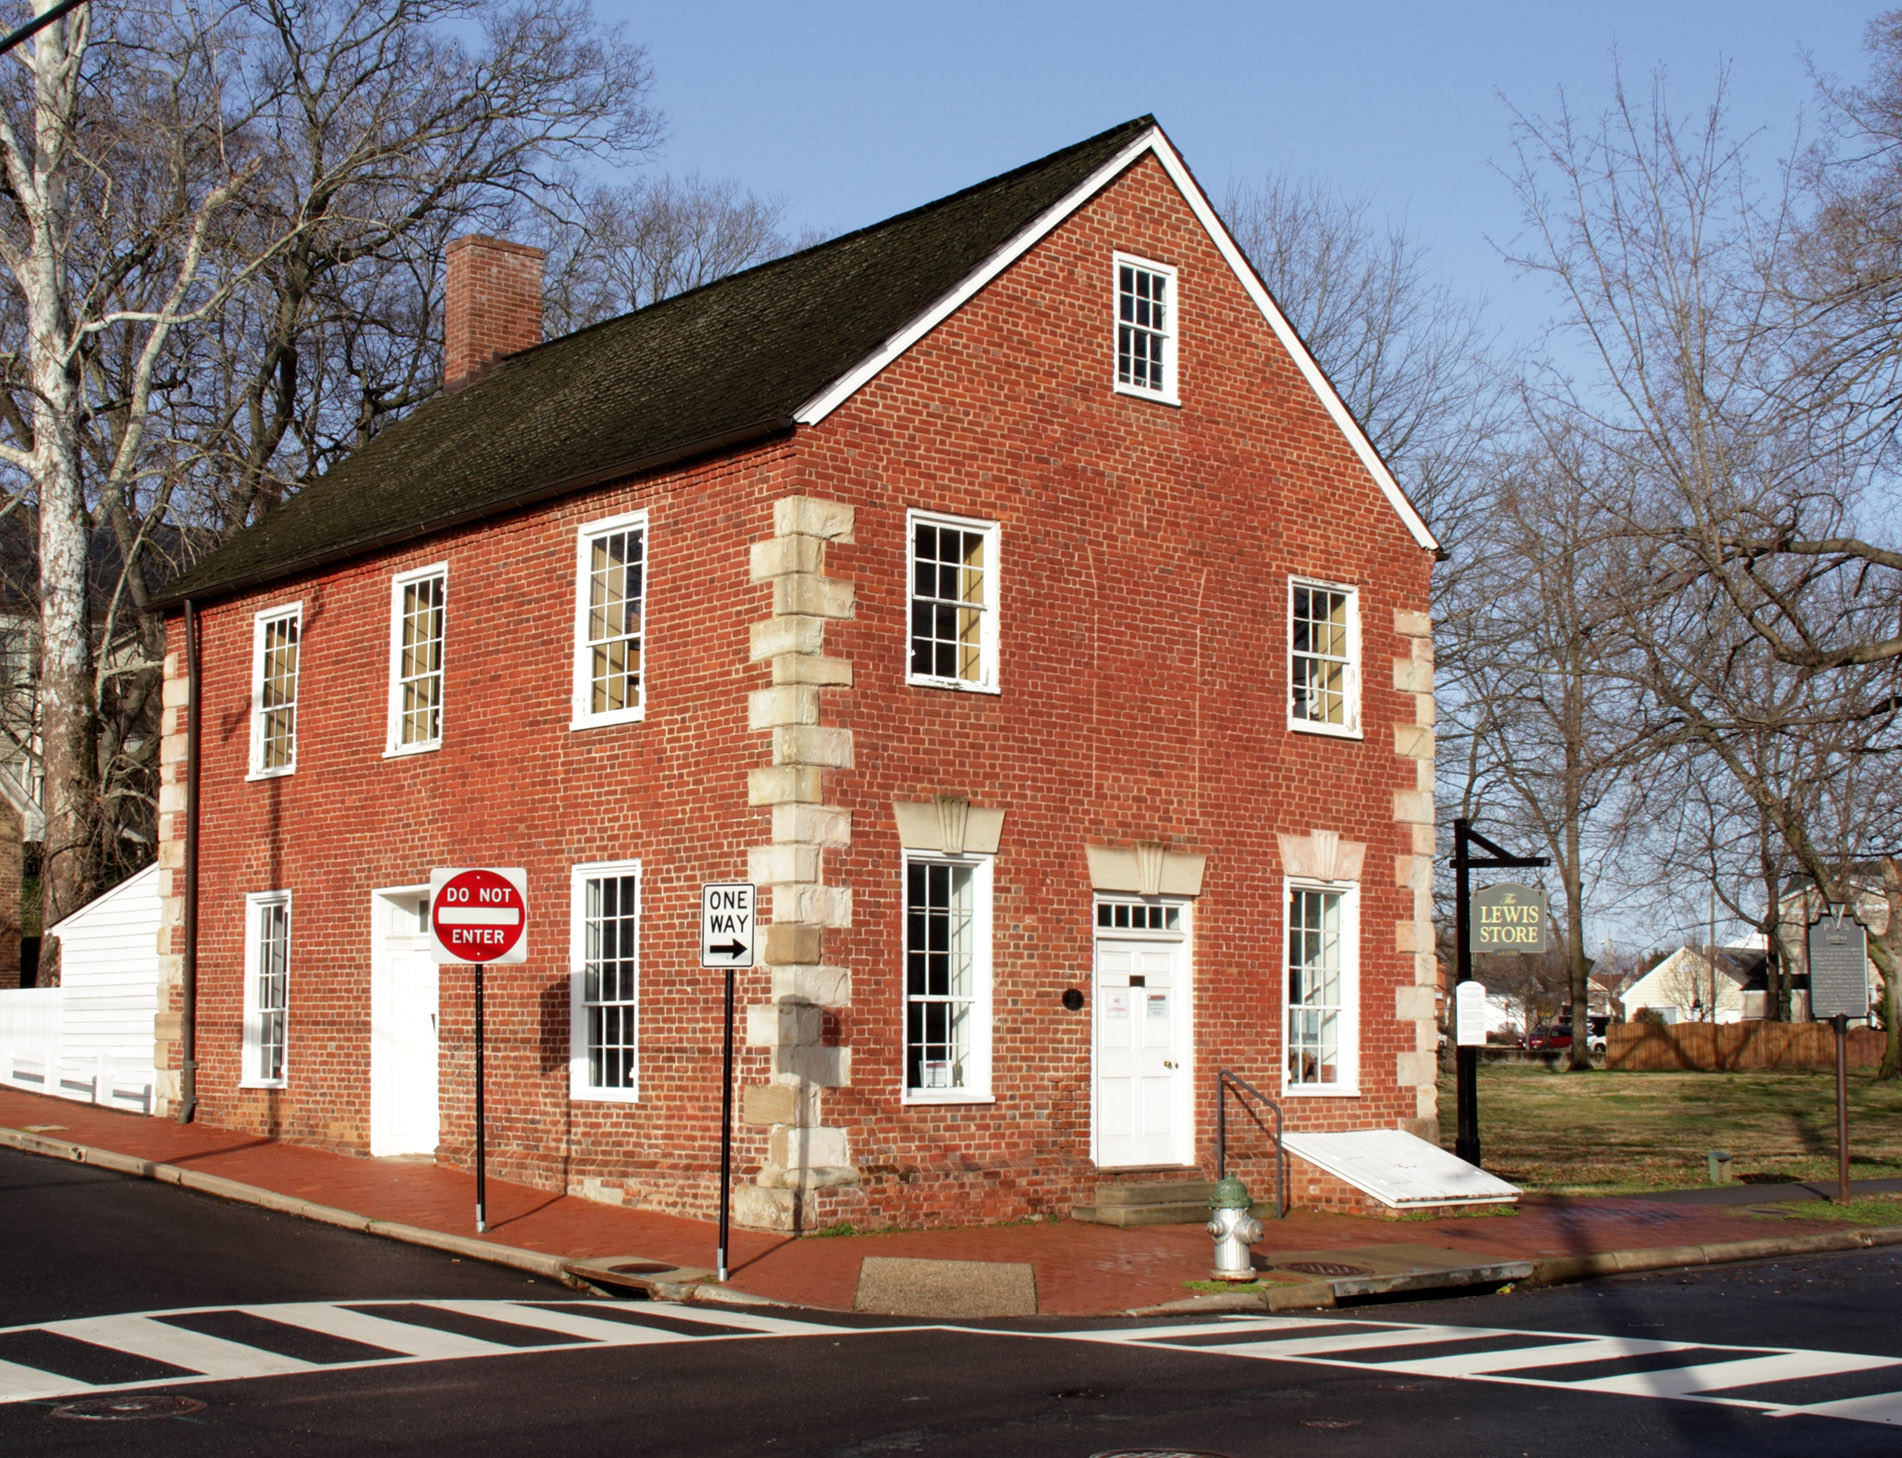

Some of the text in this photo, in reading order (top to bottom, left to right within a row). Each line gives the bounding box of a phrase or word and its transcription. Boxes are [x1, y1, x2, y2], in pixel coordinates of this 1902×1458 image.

[447, 887, 512, 903] DO NOT
[710, 890, 748, 910] ONE
[1480, 905, 1539, 924] LEWIS
[710, 914, 749, 934] WAY
[452, 929, 505, 944] ENTER
[1480, 926, 1539, 943] STORE
